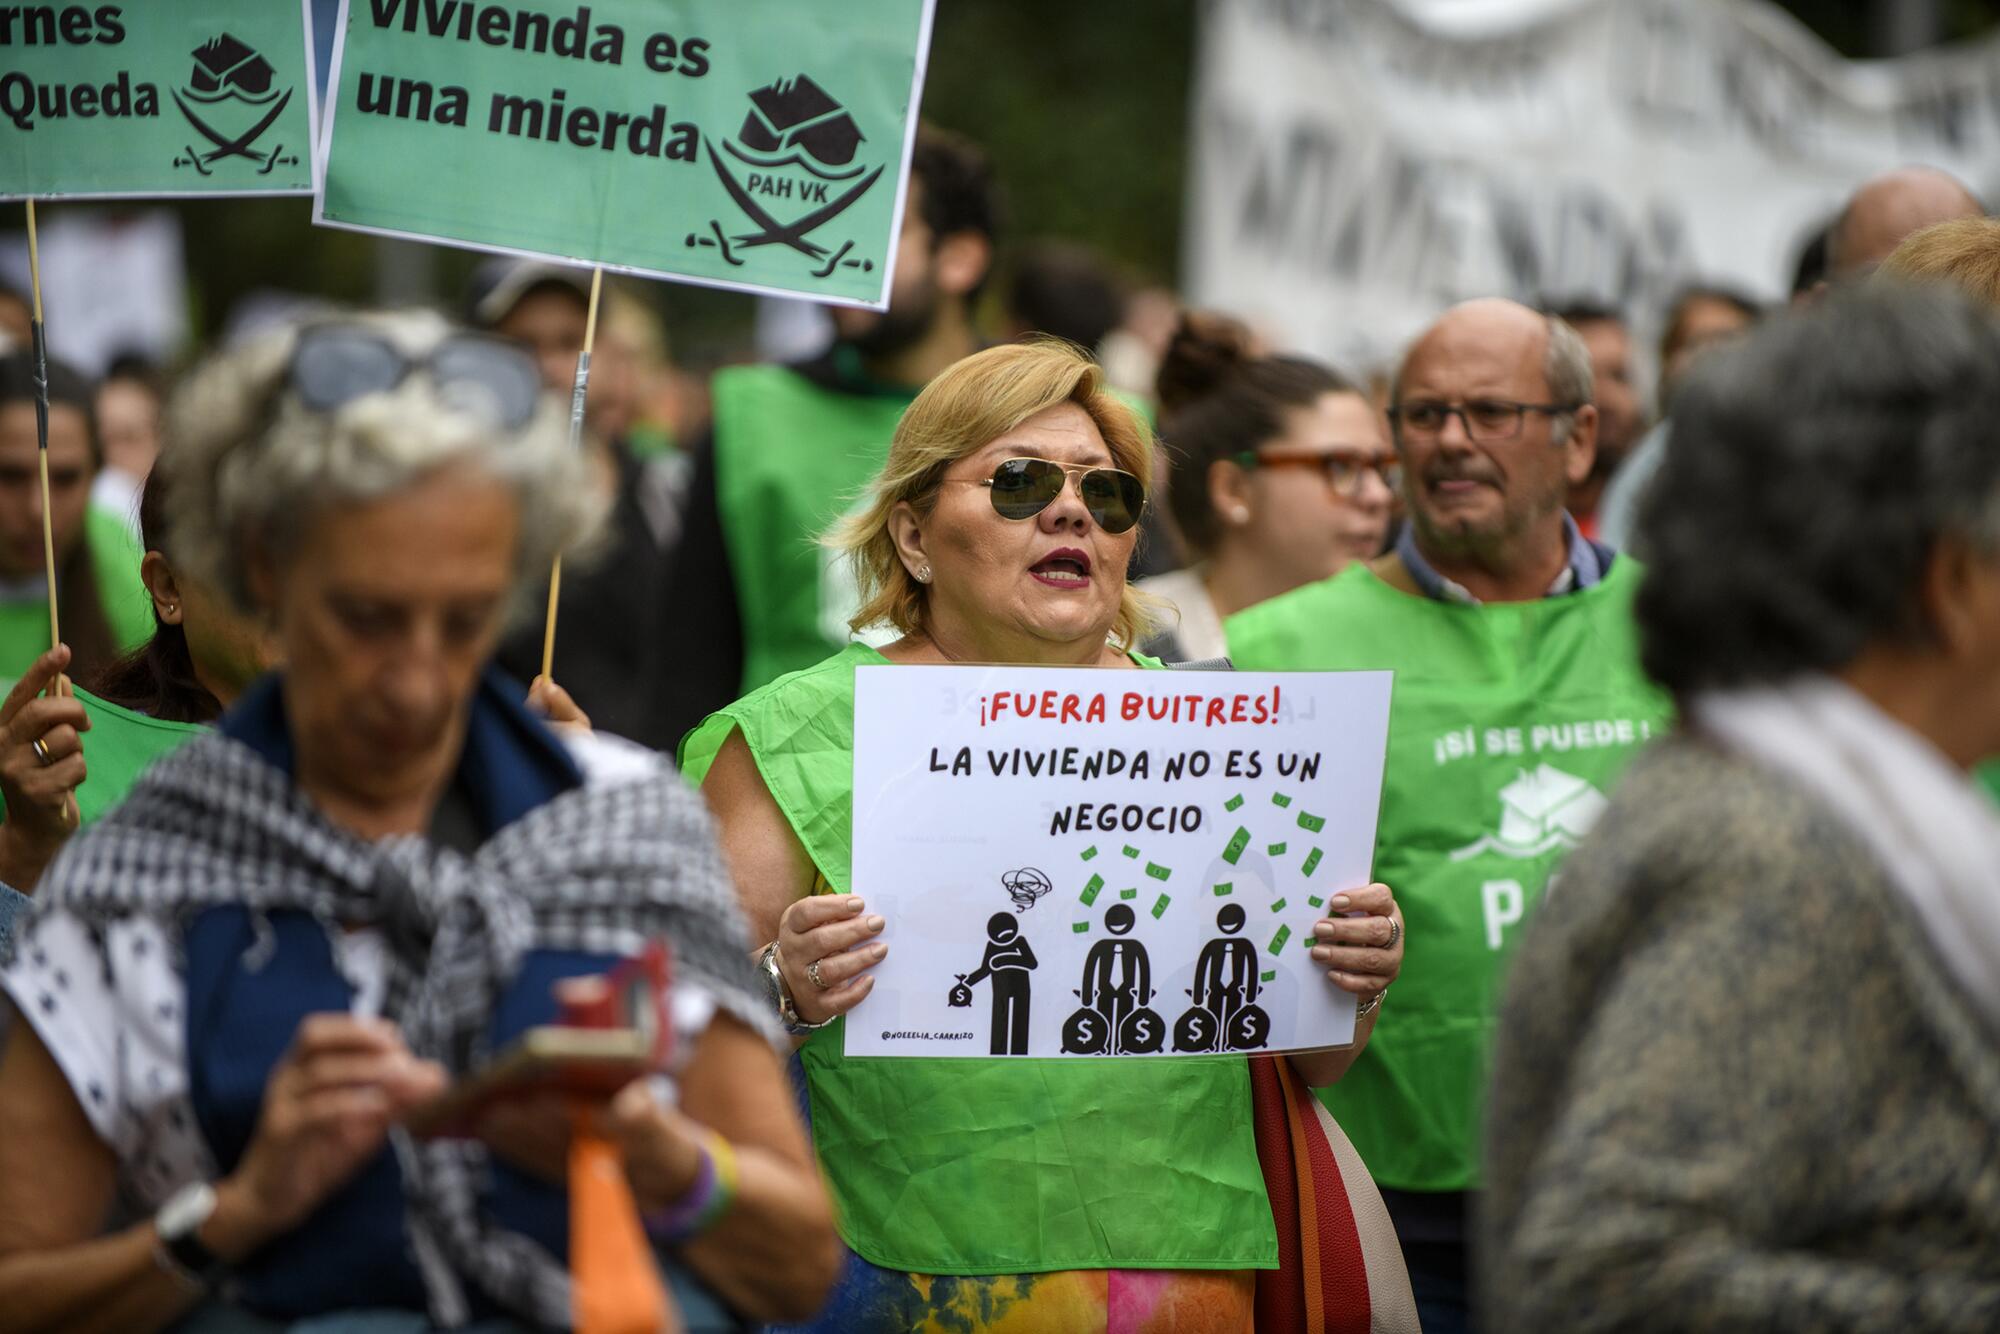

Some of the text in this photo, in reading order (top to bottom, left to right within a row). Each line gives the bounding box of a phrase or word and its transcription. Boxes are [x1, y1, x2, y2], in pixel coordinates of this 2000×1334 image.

[643, 32, 711, 77] es
[0, 70, 160, 130] Queda
[355, 71, 700, 163] una mierda
[747, 172, 830, 203] PAH VK
[980, 691, 1105, 727] ¡FUERA
[1120, 686, 1281, 728] BUITRES!
[1484, 728, 1523, 756] SE
[1531, 719, 1634, 753] PUEDE
[929, 747, 1321, 783] LA VIVIENDA NO ES UN
[1050, 803, 1202, 836] NEGOCIO
